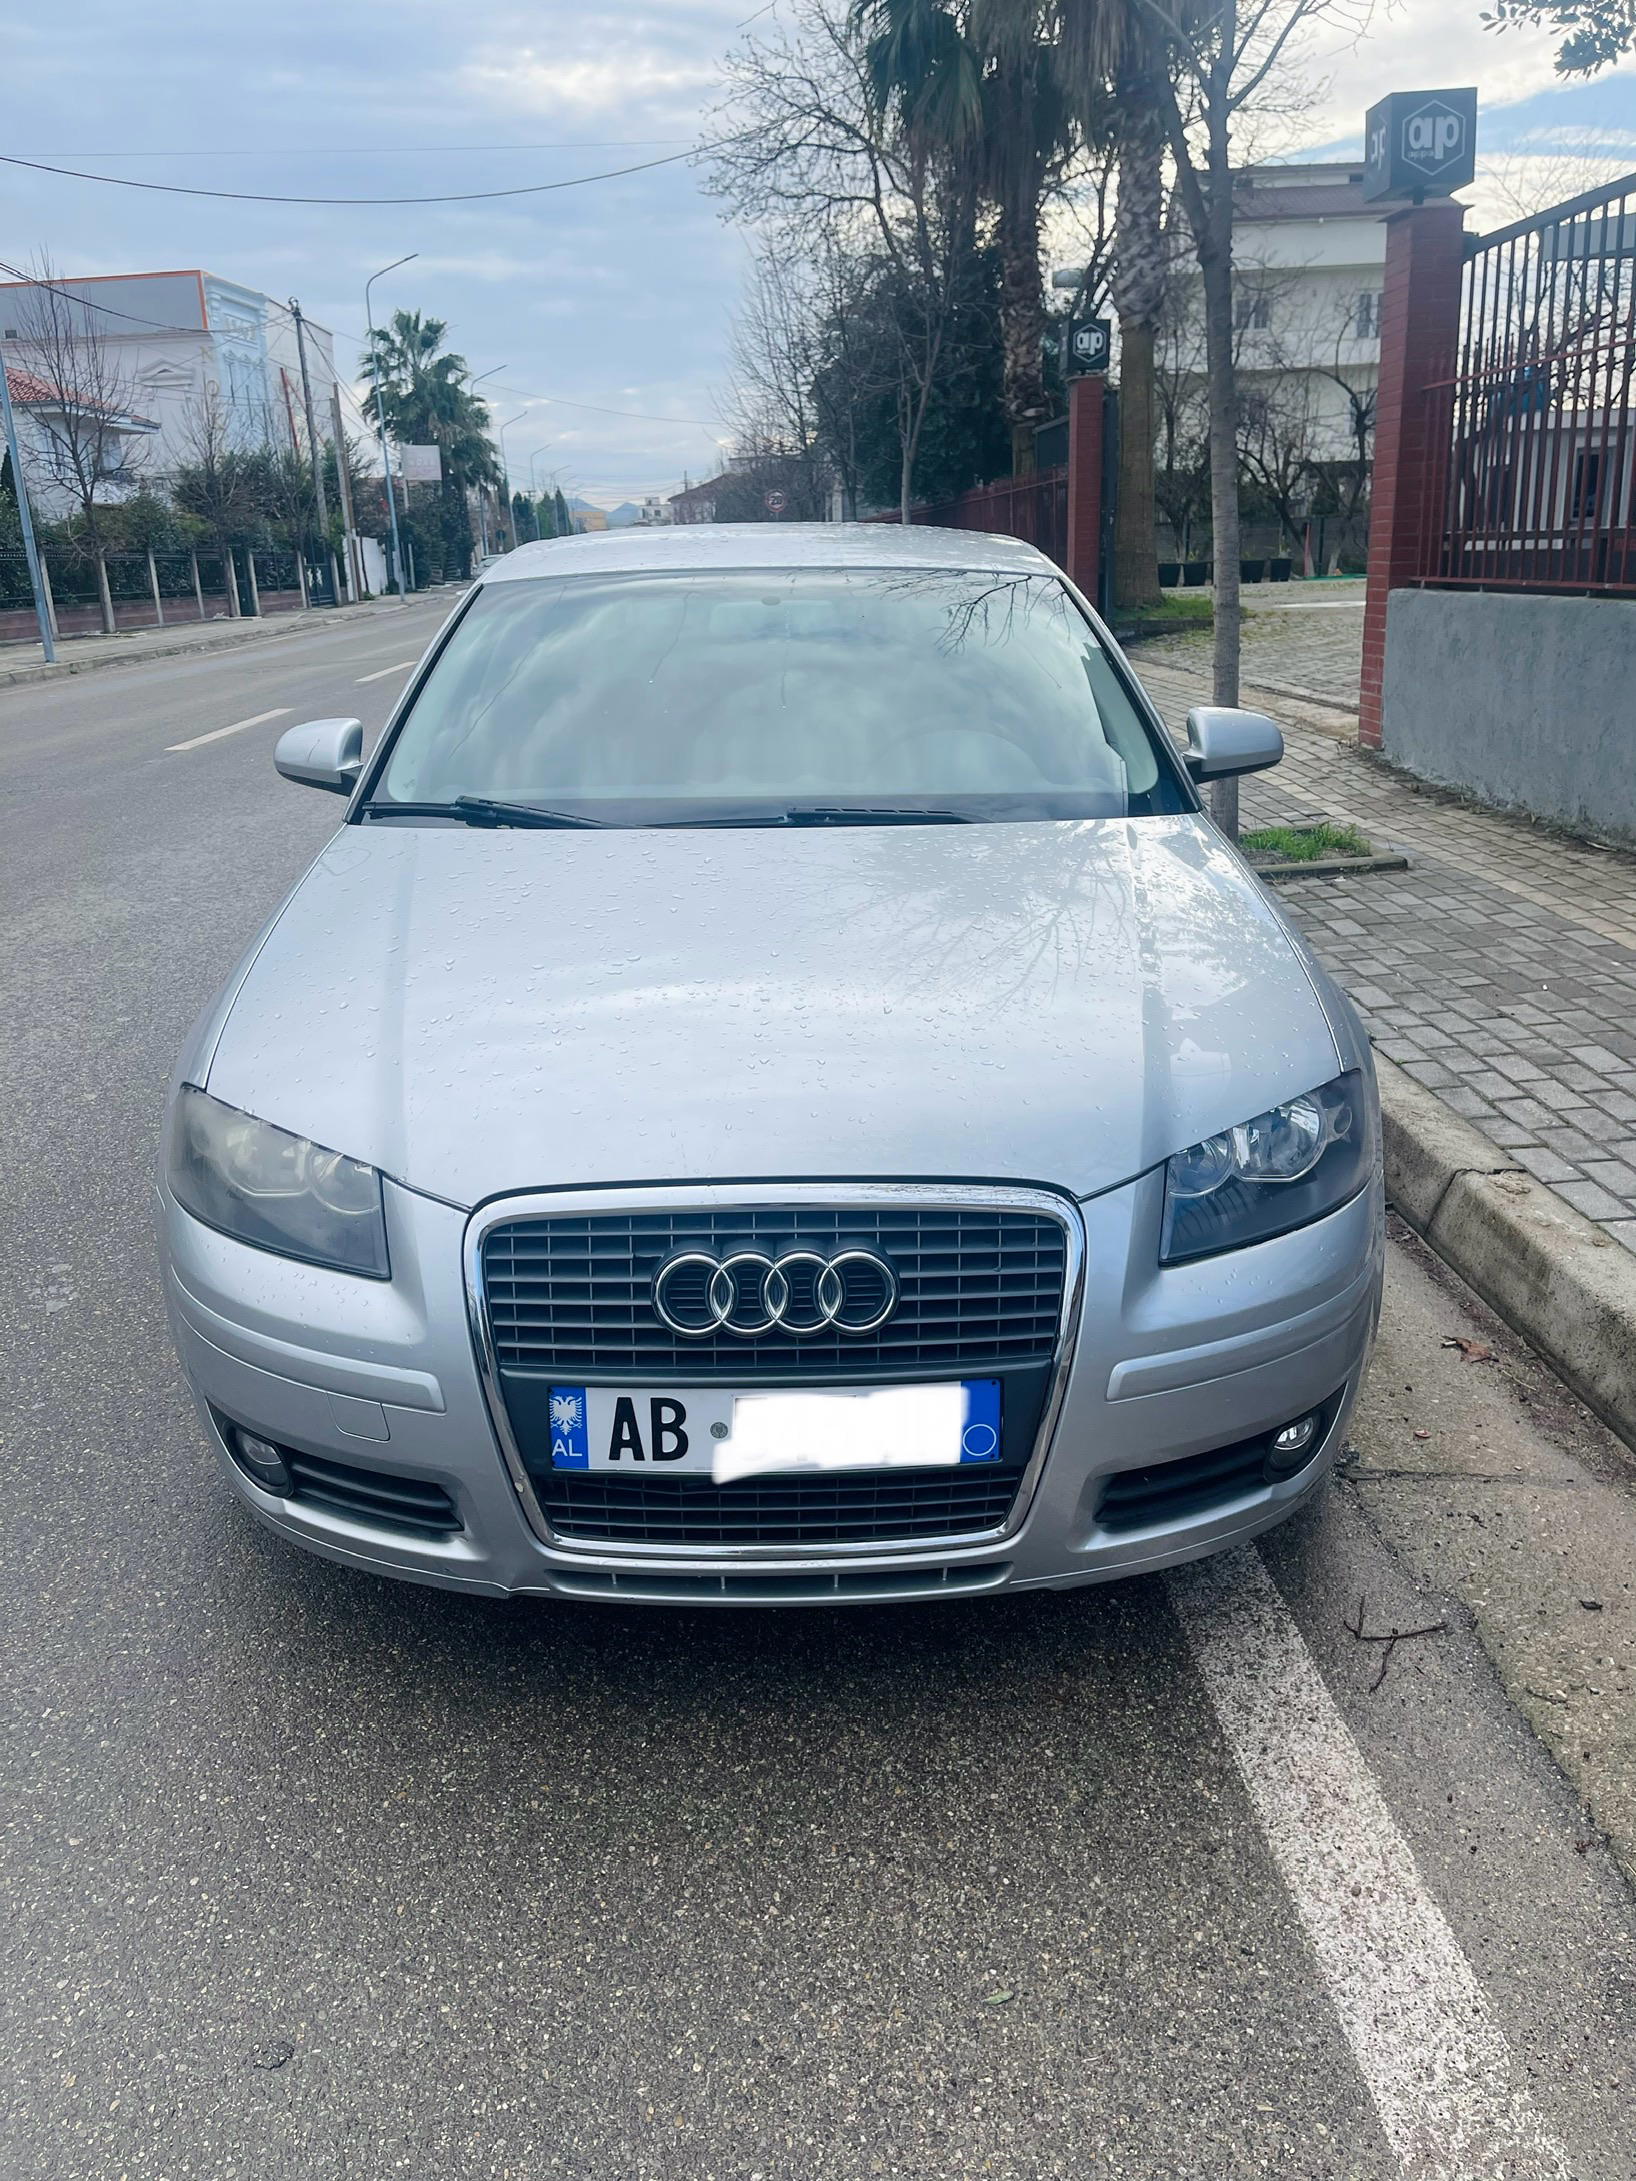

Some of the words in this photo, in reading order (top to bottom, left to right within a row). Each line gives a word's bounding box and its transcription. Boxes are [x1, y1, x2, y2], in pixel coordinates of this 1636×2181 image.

[1408, 115, 1460, 160] ap
[1077, 332, 1103, 355] ap
[608, 1396, 689, 1461] AB
[551, 1438, 583, 1457] AL
